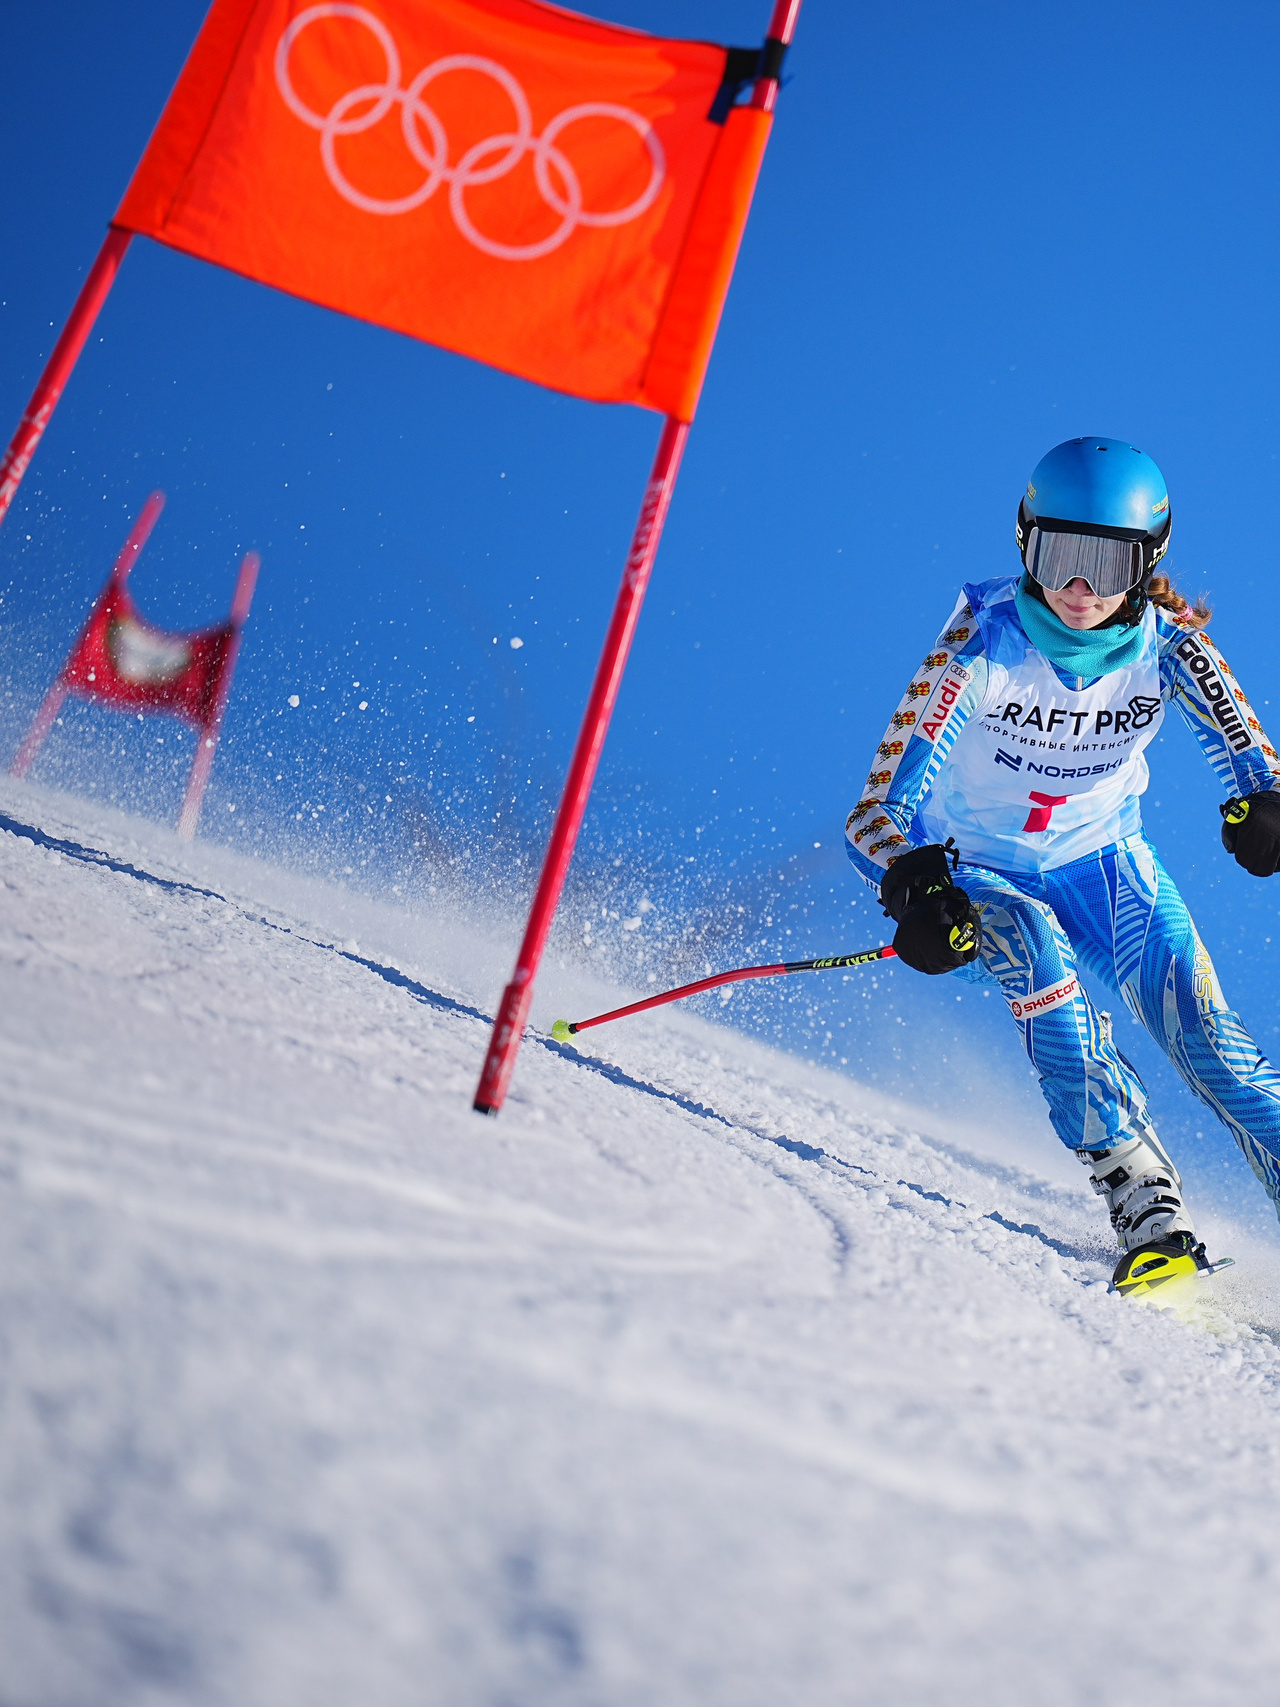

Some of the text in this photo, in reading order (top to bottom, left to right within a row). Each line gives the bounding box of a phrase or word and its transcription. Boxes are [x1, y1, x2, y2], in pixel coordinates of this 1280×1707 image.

[922, 678, 961, 741] Audi
[1095, 702, 1157, 734] PRO
[1026, 757, 1123, 779] NORDSKI
[953, 928, 972, 949] LEKI
